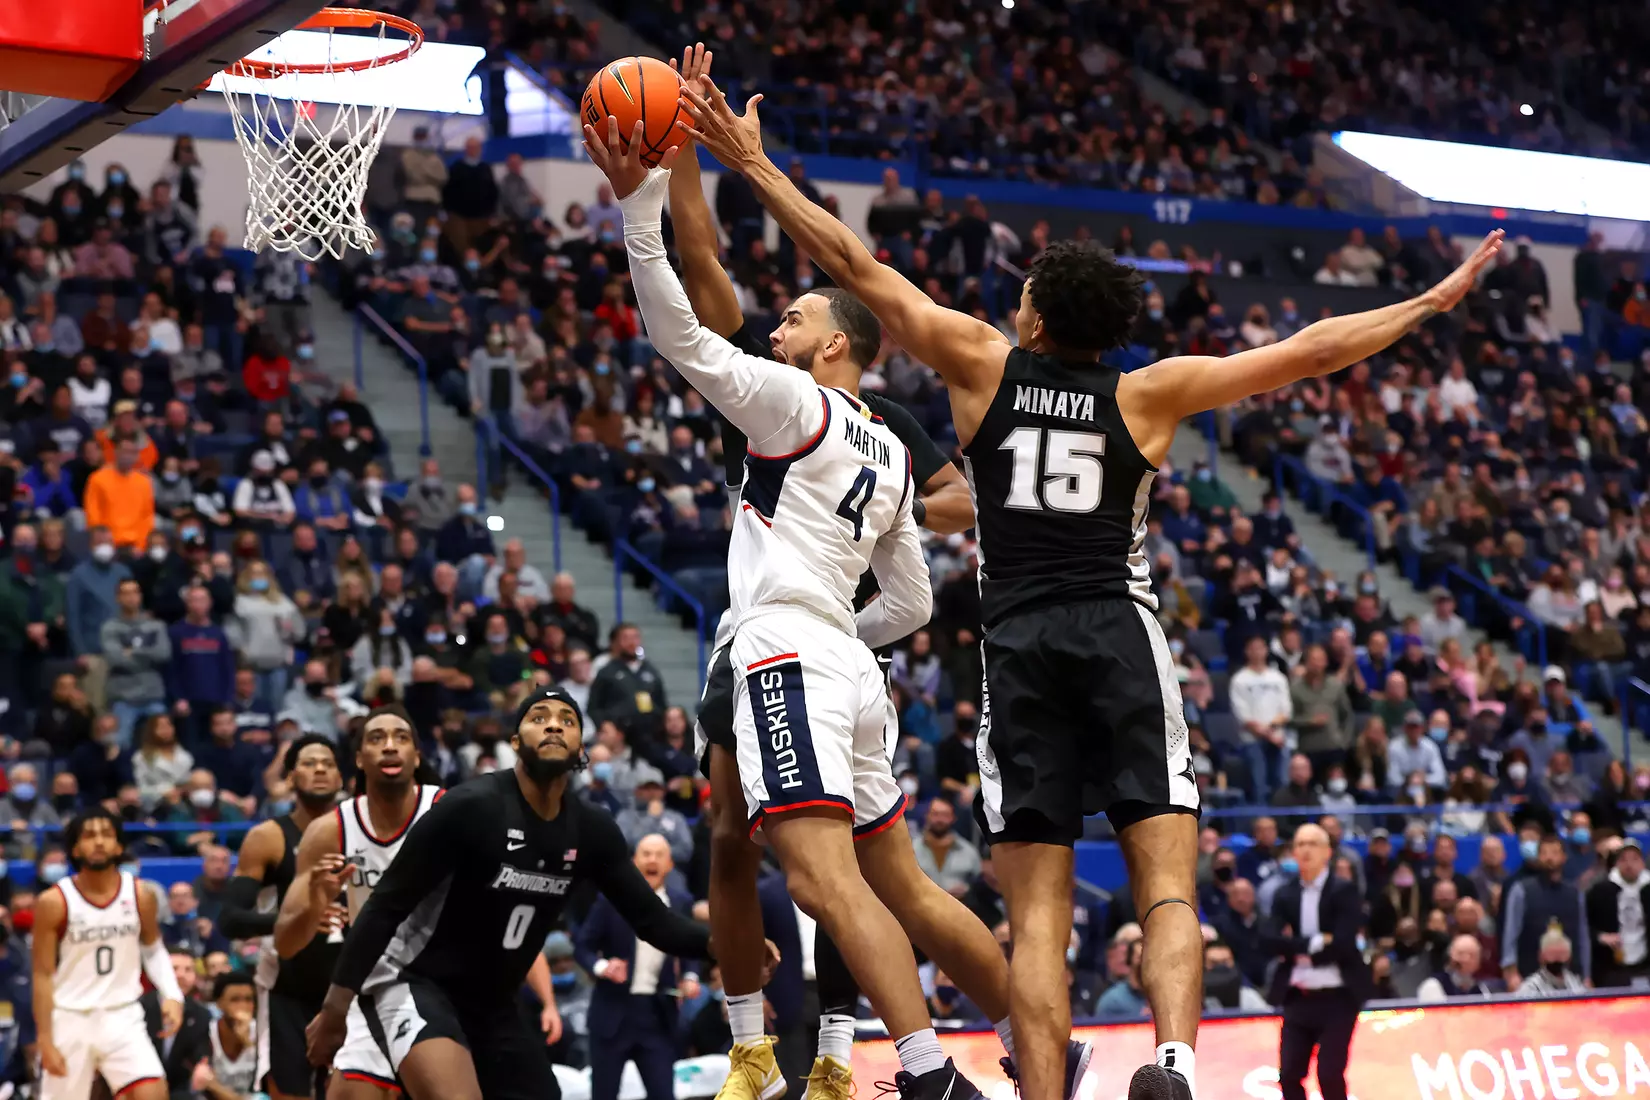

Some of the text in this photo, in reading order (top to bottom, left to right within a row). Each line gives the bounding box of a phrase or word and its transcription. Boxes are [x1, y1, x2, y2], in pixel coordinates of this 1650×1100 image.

[1153, 198, 1192, 224] 117
[1013, 385, 1095, 421] MINAYA
[844, 417, 890, 469] MARTIN
[998, 427, 1106, 513] 15
[836, 465, 877, 542] 4
[760, 671, 803, 790] HUSKIES
[492, 866, 571, 895] PROVIDENCE
[502, 904, 536, 950] 0
[96, 945, 114, 976] 0
[1411, 1041, 1650, 1100] MOHEGA
